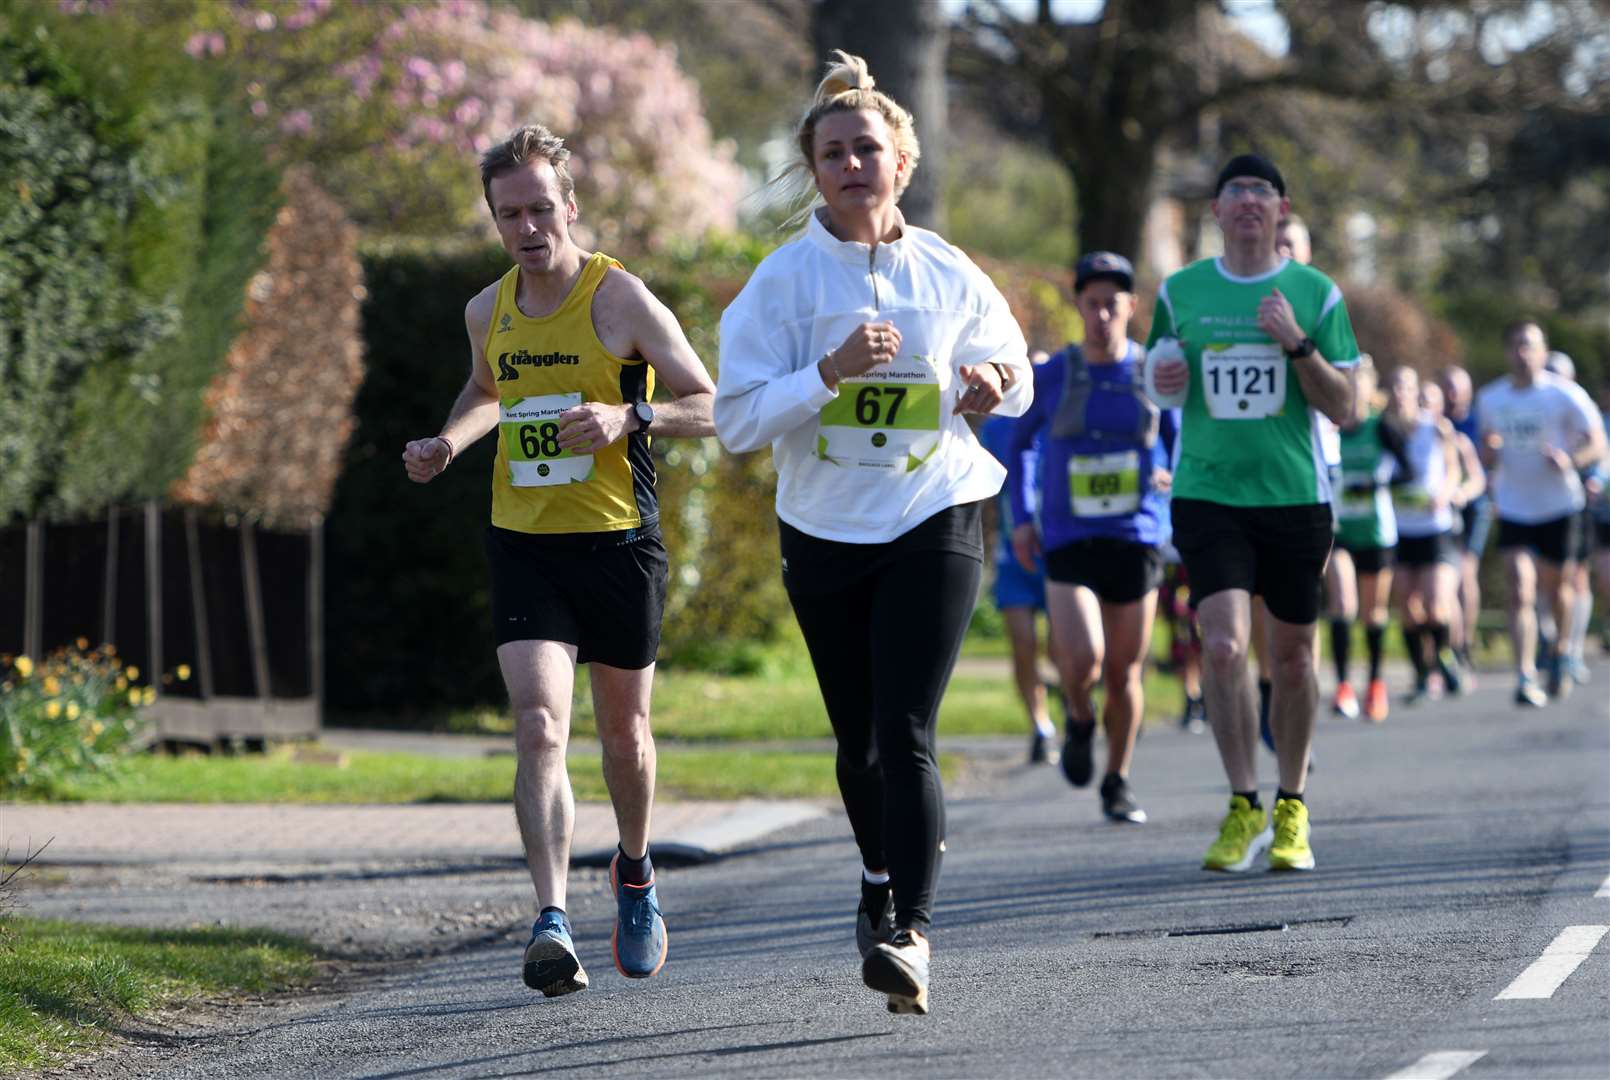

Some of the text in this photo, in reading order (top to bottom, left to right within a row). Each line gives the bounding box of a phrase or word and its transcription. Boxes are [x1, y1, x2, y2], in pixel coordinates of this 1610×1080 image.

[497, 351, 580, 381] Stragglers
[889, 371, 927, 379] Marathon
[1208, 366, 1276, 395] 1121
[518, 410, 540, 419] Spring
[540, 407, 569, 416] Marath
[856, 386, 907, 425] 67
[519, 422, 562, 459] 68
